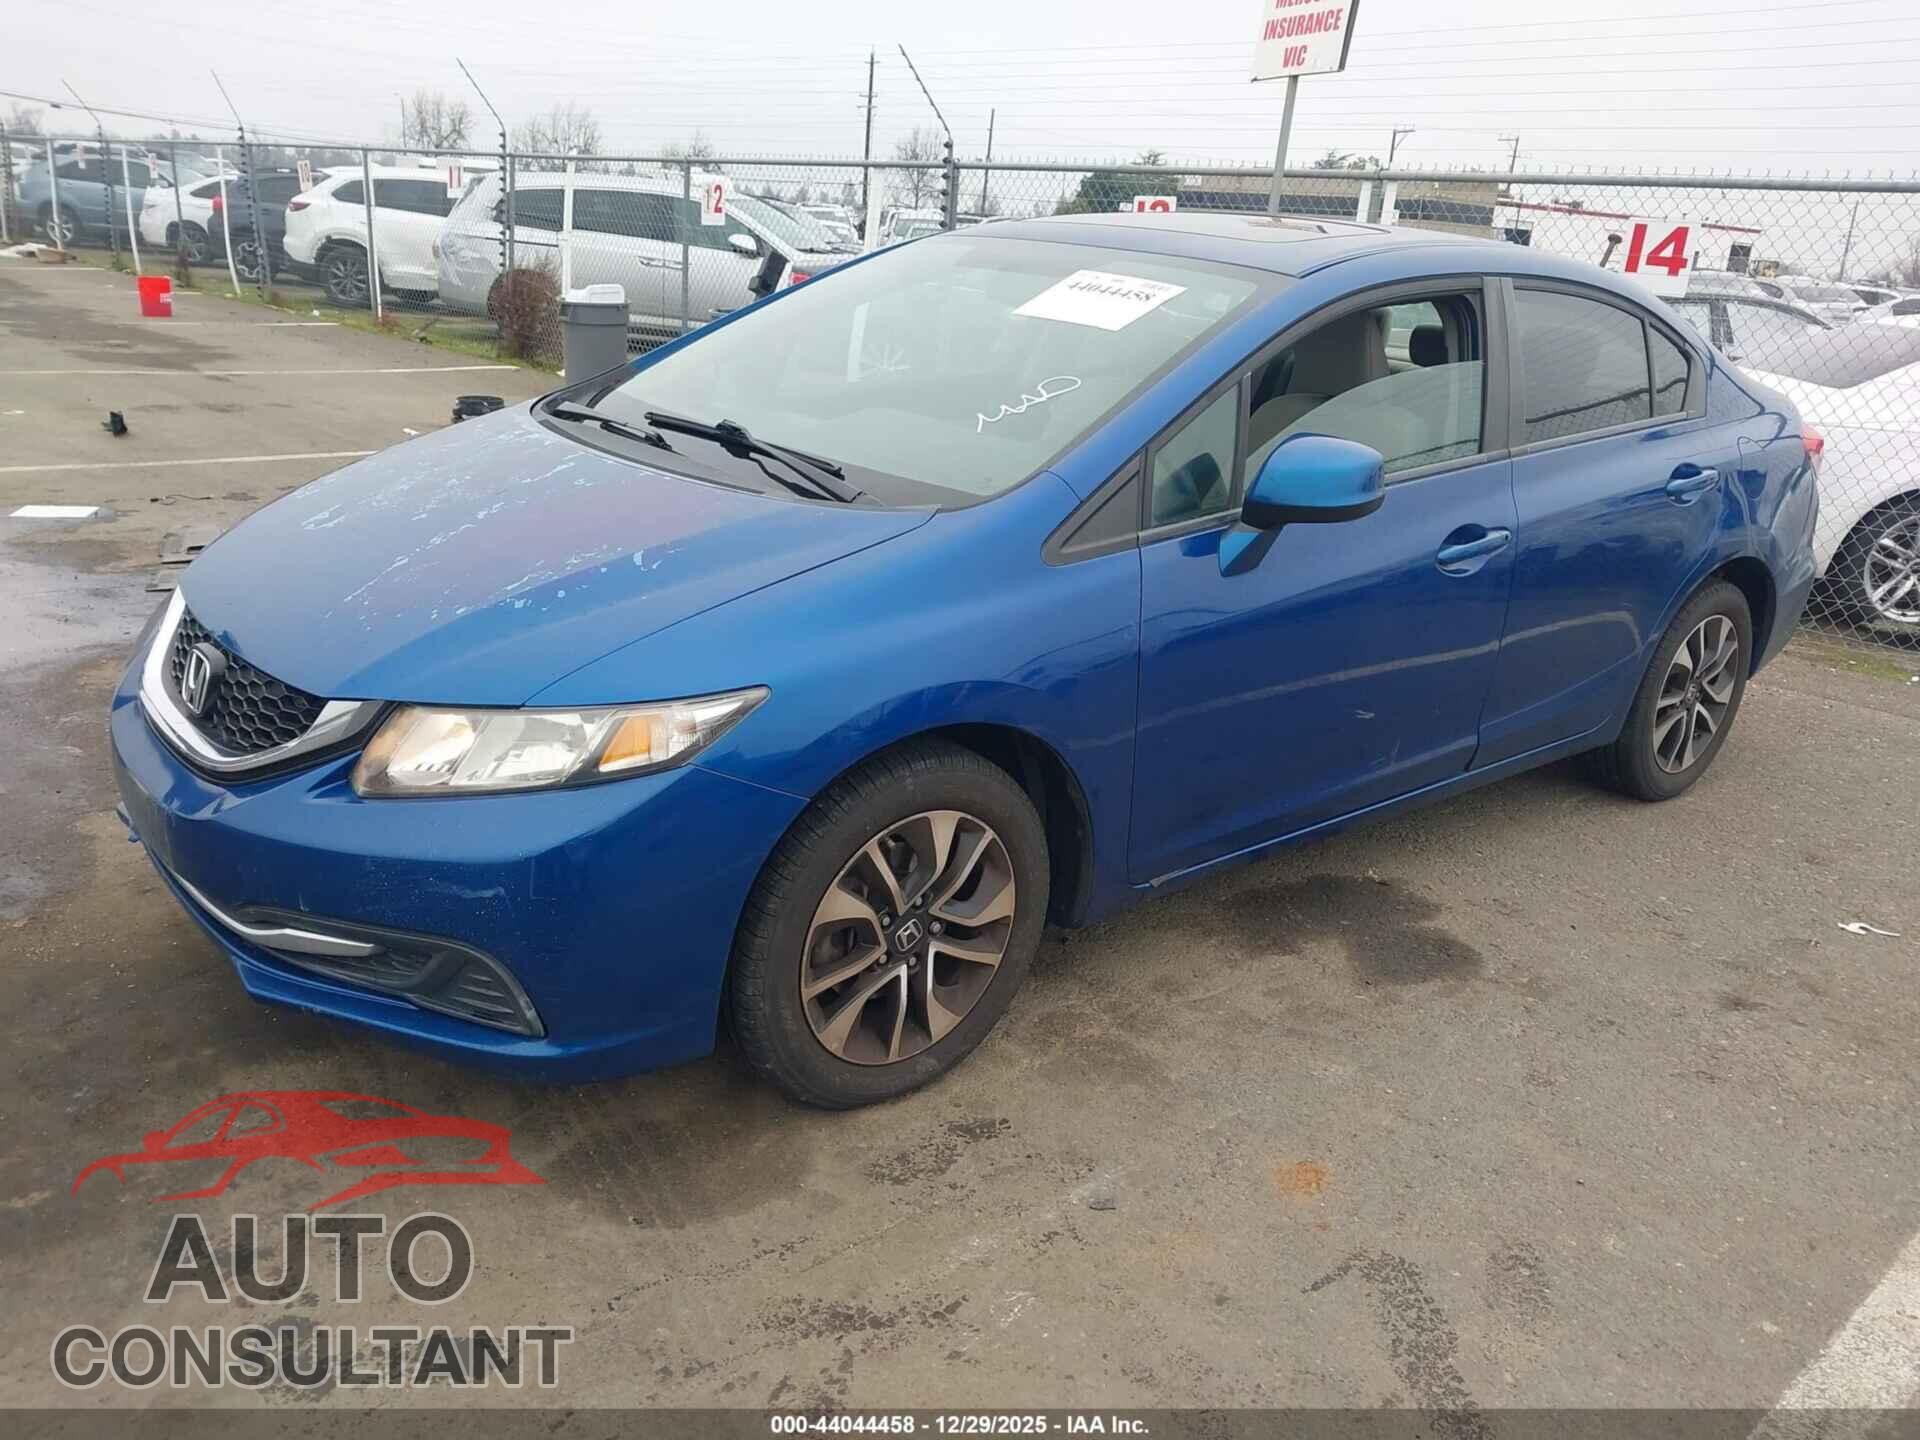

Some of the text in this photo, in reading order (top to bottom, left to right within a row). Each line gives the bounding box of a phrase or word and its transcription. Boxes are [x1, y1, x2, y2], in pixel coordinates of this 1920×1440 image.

[1263, 8, 1344, 41] INSURANCE
[1282, 45, 1308, 68] VIC
[1624, 223, 1690, 277] 14
